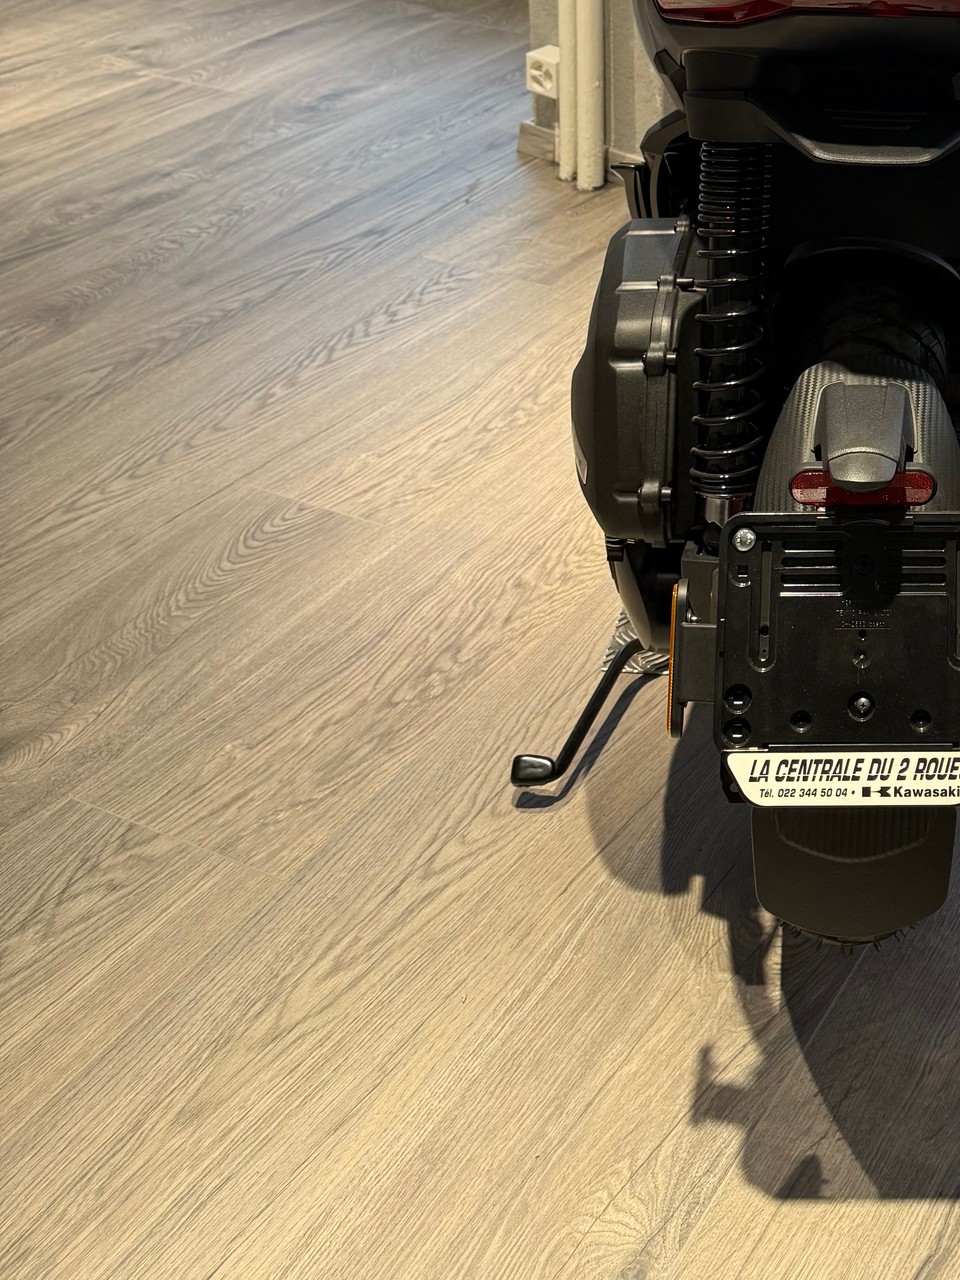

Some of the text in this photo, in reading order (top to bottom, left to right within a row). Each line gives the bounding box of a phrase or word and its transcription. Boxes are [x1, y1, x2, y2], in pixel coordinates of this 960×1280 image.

[748, 759, 771, 782] LA
[775, 758, 866, 782] CENTRALE
[867, 758, 895, 781] DU
[896, 757, 910, 780] 2
[760, 786, 960, 798] Tél. 022 344 50 04 Kawasaki
